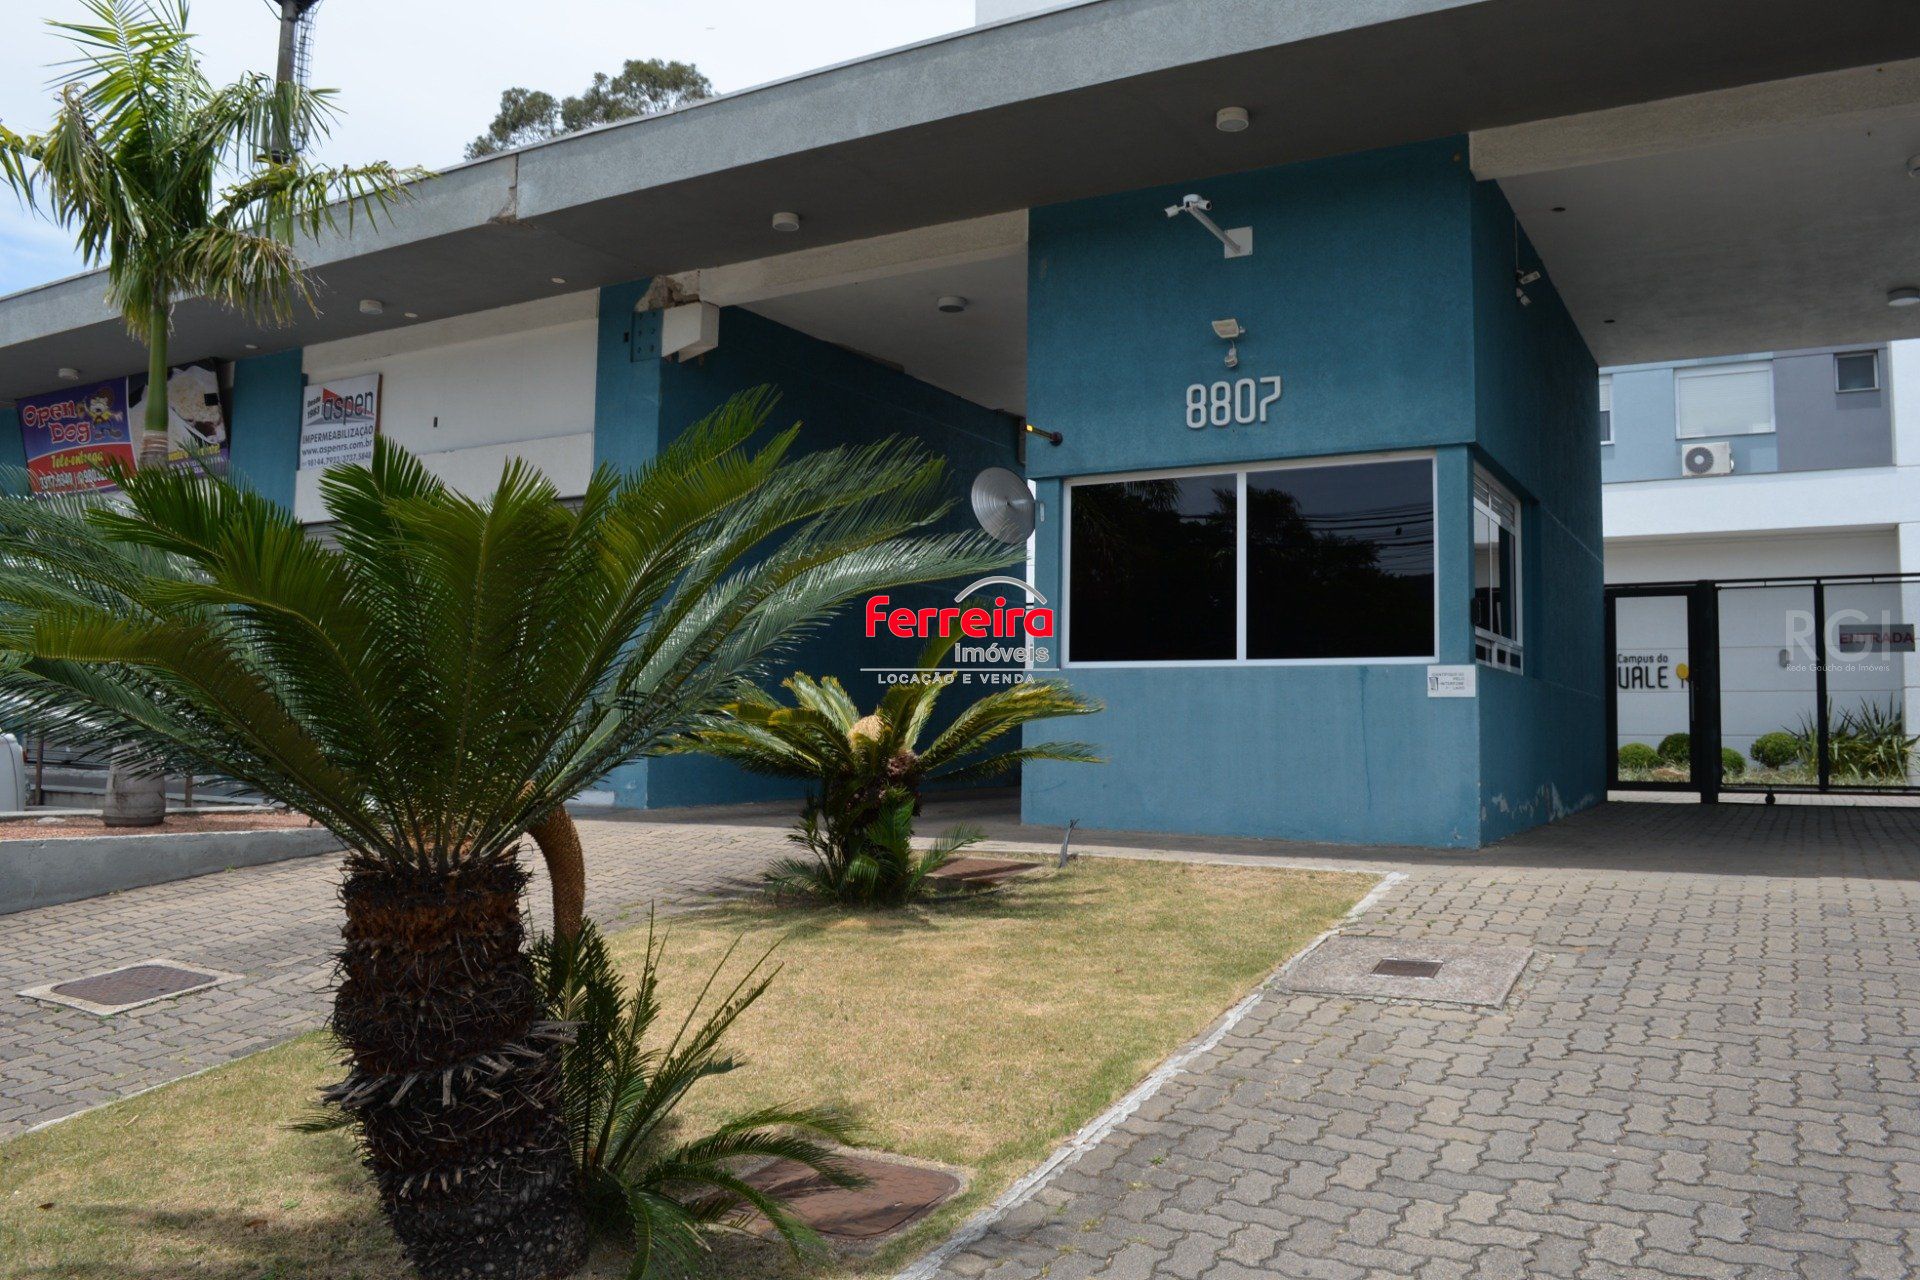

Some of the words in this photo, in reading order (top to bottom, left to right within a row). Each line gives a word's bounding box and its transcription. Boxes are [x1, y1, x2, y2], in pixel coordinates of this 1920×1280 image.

[323, 391, 374, 425] aspen
[1186, 376, 1281, 429] 8807
[23, 400, 78, 429] Open
[50, 421, 91, 443] Dog
[302, 424, 374, 444] IMPERMEABILIZAÇÃO
[302, 439, 372, 457] www.aspenrs.com.br
[1840, 632, 1914, 644] ENTRADA
[1617, 653, 1654, 664] Campus
[1657, 653, 1668, 663] do
